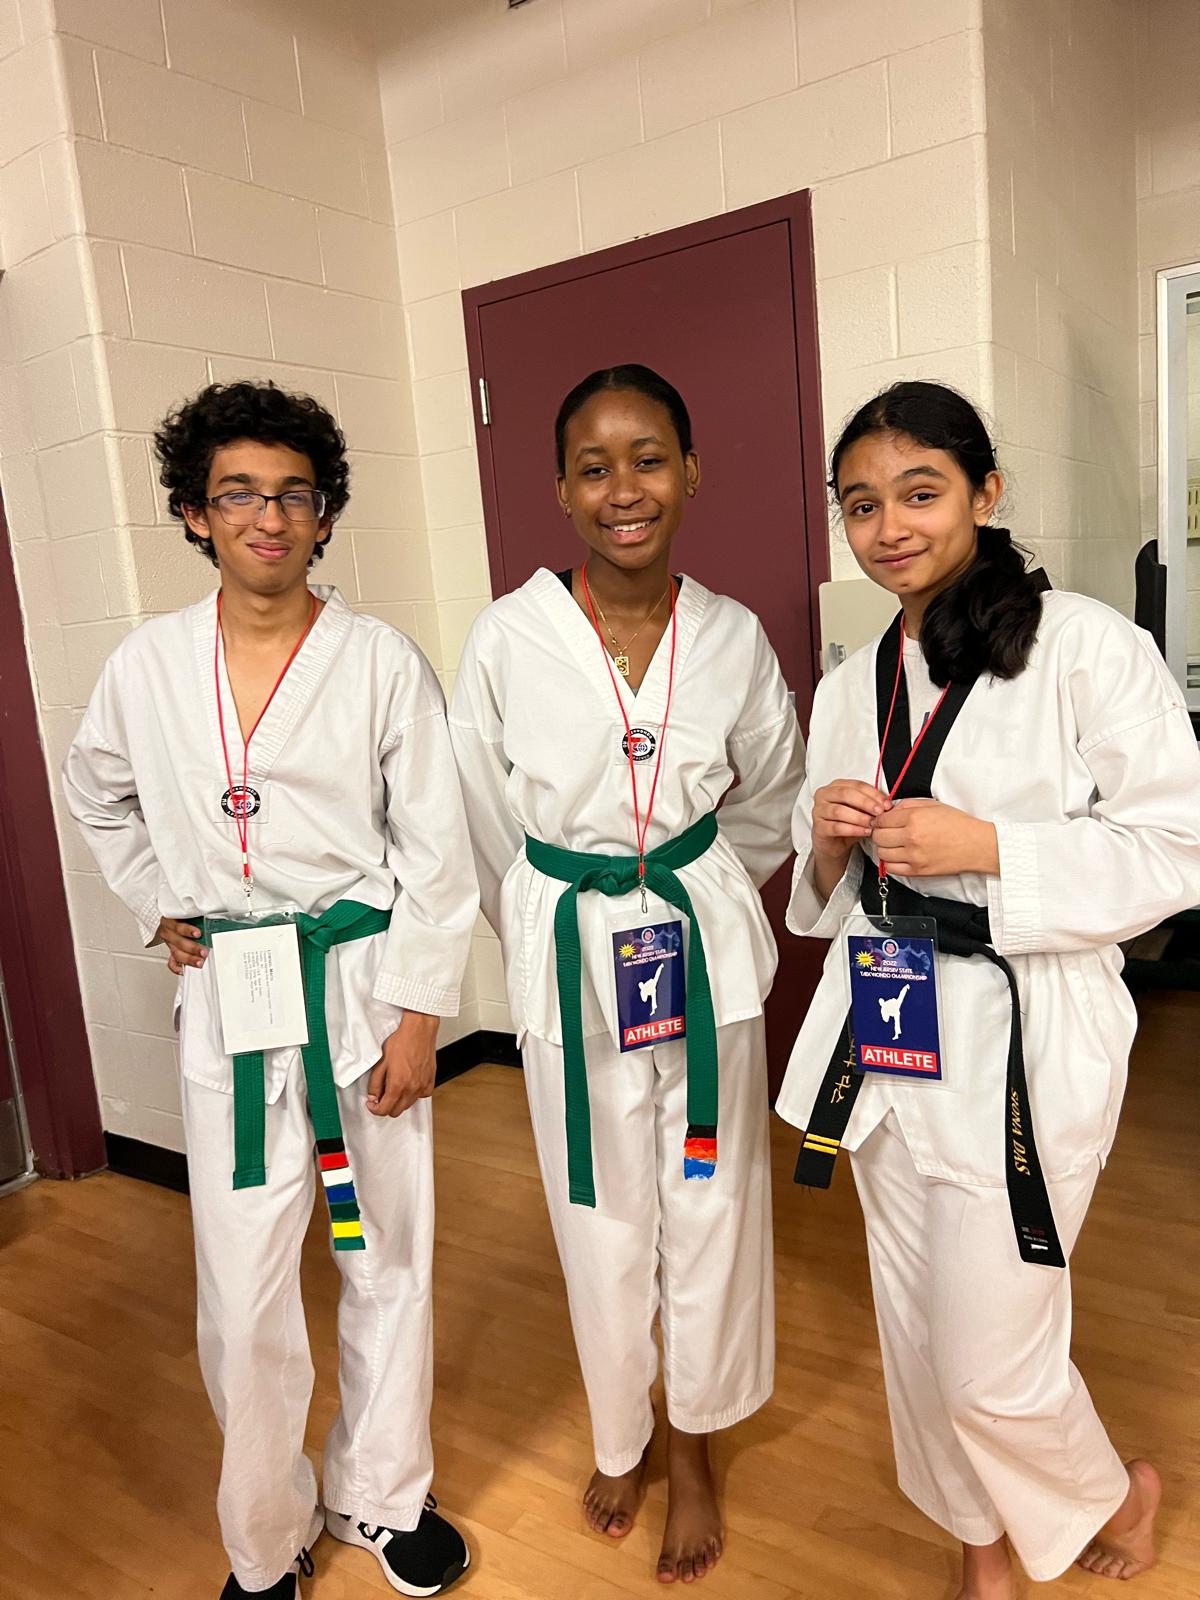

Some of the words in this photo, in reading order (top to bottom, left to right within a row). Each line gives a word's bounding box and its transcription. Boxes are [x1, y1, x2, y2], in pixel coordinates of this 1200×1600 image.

[626, 1018, 682, 1042] ATHLETE
[864, 1048, 934, 1068] ATHLETE
[1013, 1139, 1031, 1176] DAS
